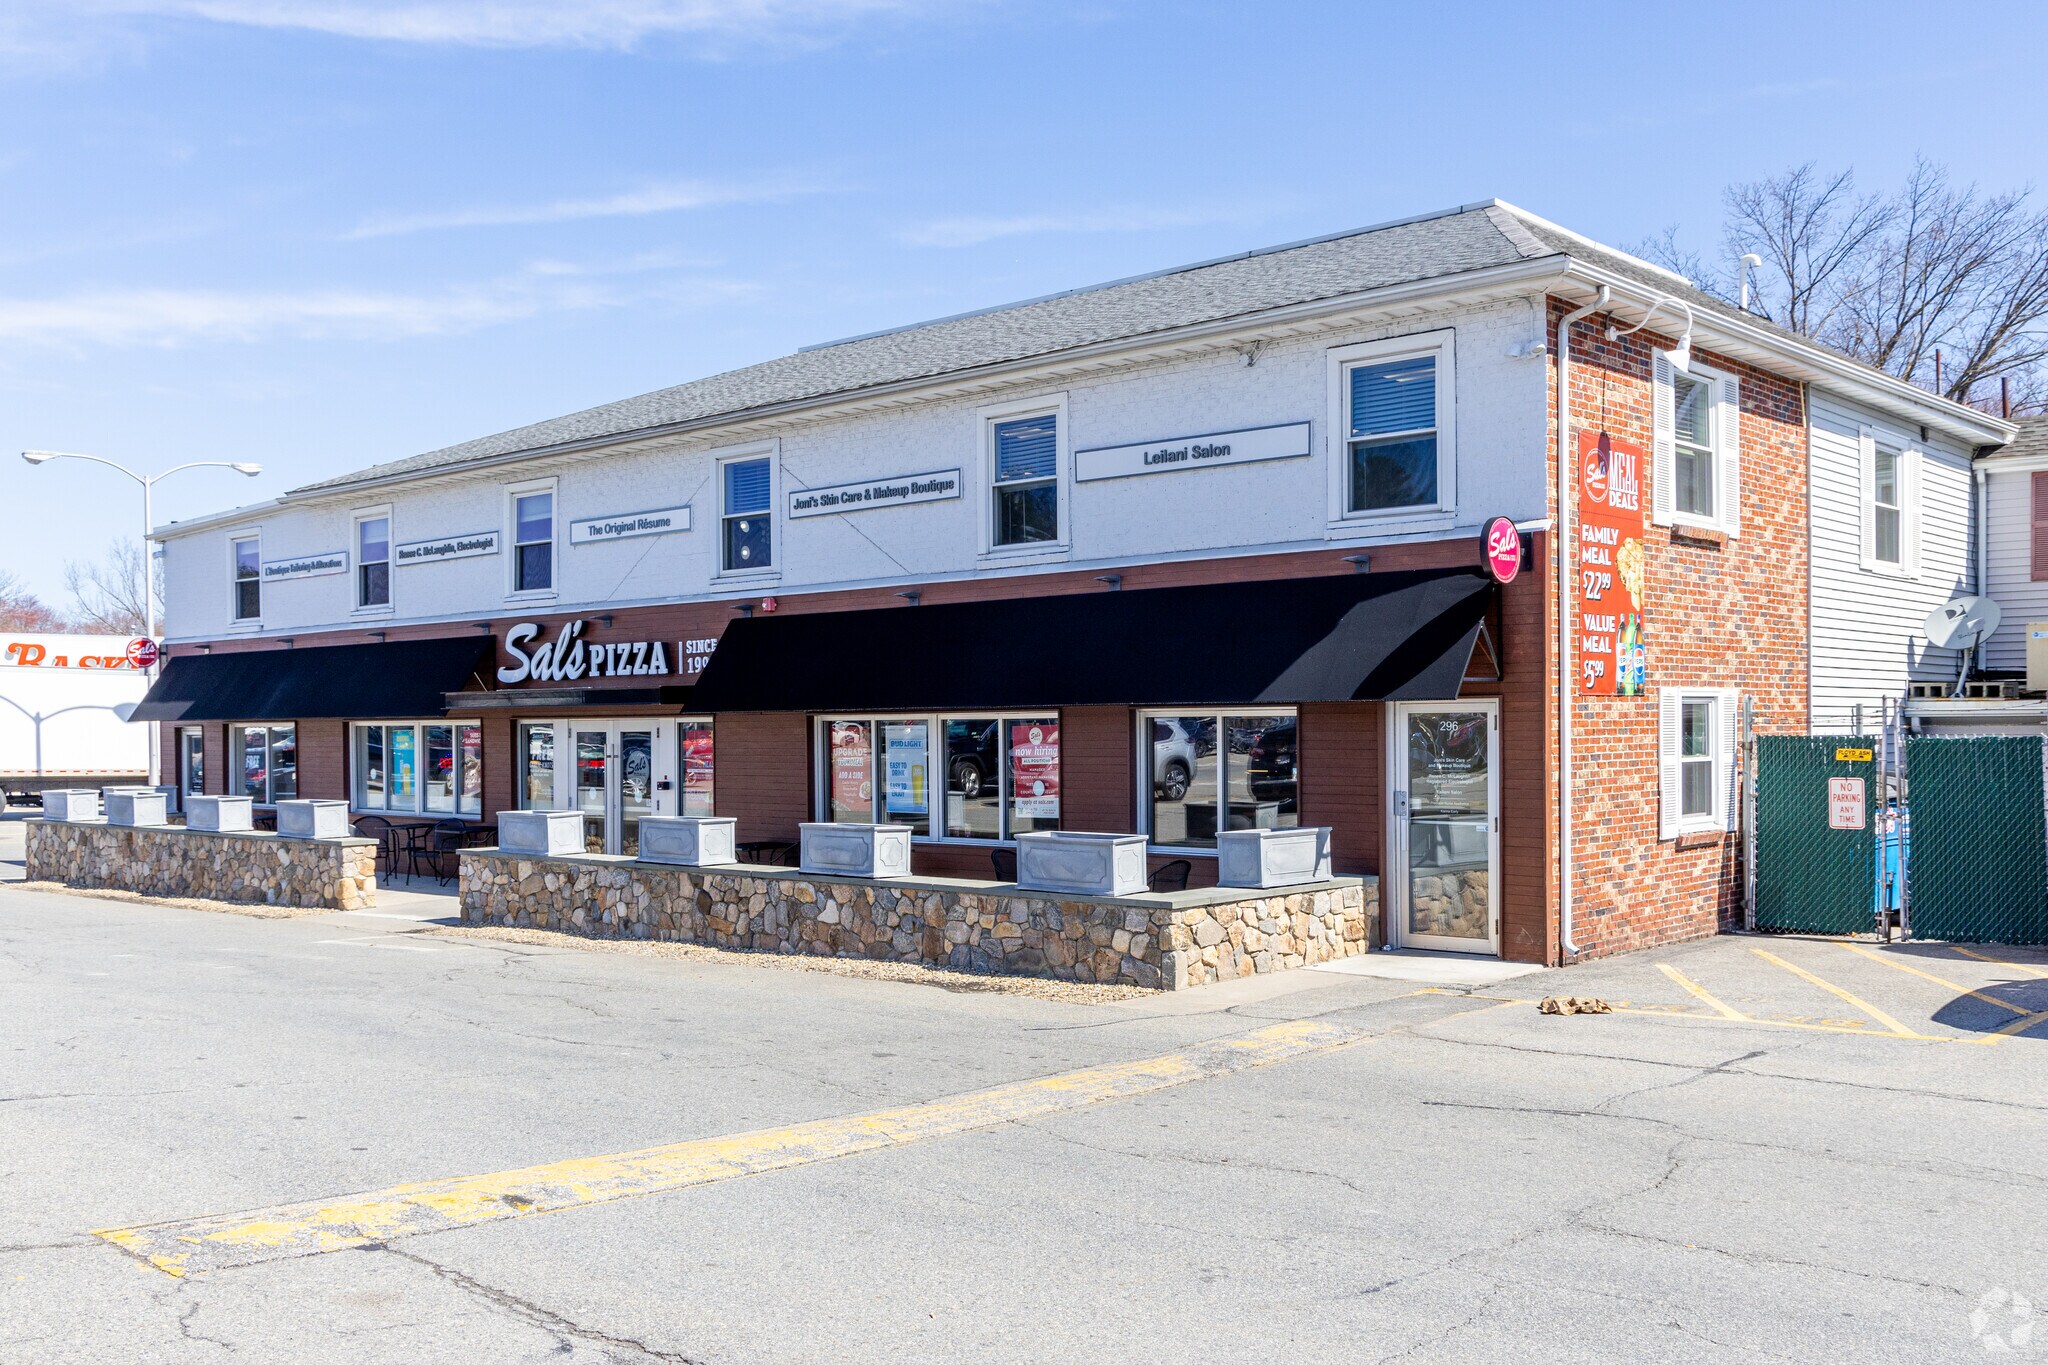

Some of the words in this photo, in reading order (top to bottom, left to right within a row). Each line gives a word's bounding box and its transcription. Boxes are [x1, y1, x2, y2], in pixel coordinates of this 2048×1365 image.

[1144, 447, 1187, 465] Leilani
[1191, 444, 1231, 459] Salon
[1609, 450, 1639, 496] MEAL
[793, 496, 819, 510] Joni's
[820, 494, 840, 506] Skin
[841, 491, 863, 504] Care
[864, 489, 872, 500] &
[873, 484, 909, 499] Makeup
[911, 479, 954, 494] Boutique
[1609, 490, 1639, 511] DEALS
[588, 525, 603, 536] The
[604, 520, 636, 535] Original
[1582, 523, 1619, 546] FAMILY
[1489, 526, 1517, 558] Sal's
[1582, 546, 1612, 565] MEAL
[1583, 613, 1616, 633] VALUE
[497, 619, 587, 684] Sal's
[588, 641, 668, 677] PIZZA
[686, 638, 718, 654] SINCE
[1583, 635, 1612, 654] MEAL
[1440, 721, 1458, 731] 296
[890, 740, 903, 748] BUD
[904, 740, 921, 748] LIGHT
[1015, 748, 1031, 756] now
[1034, 745, 1058, 758] hiring
[627, 757, 647, 775] Sal's
[1840, 783, 1853, 791] NO
[1833, 793, 1860, 803] PARKING
[1839, 815, 1855, 823] TIME
